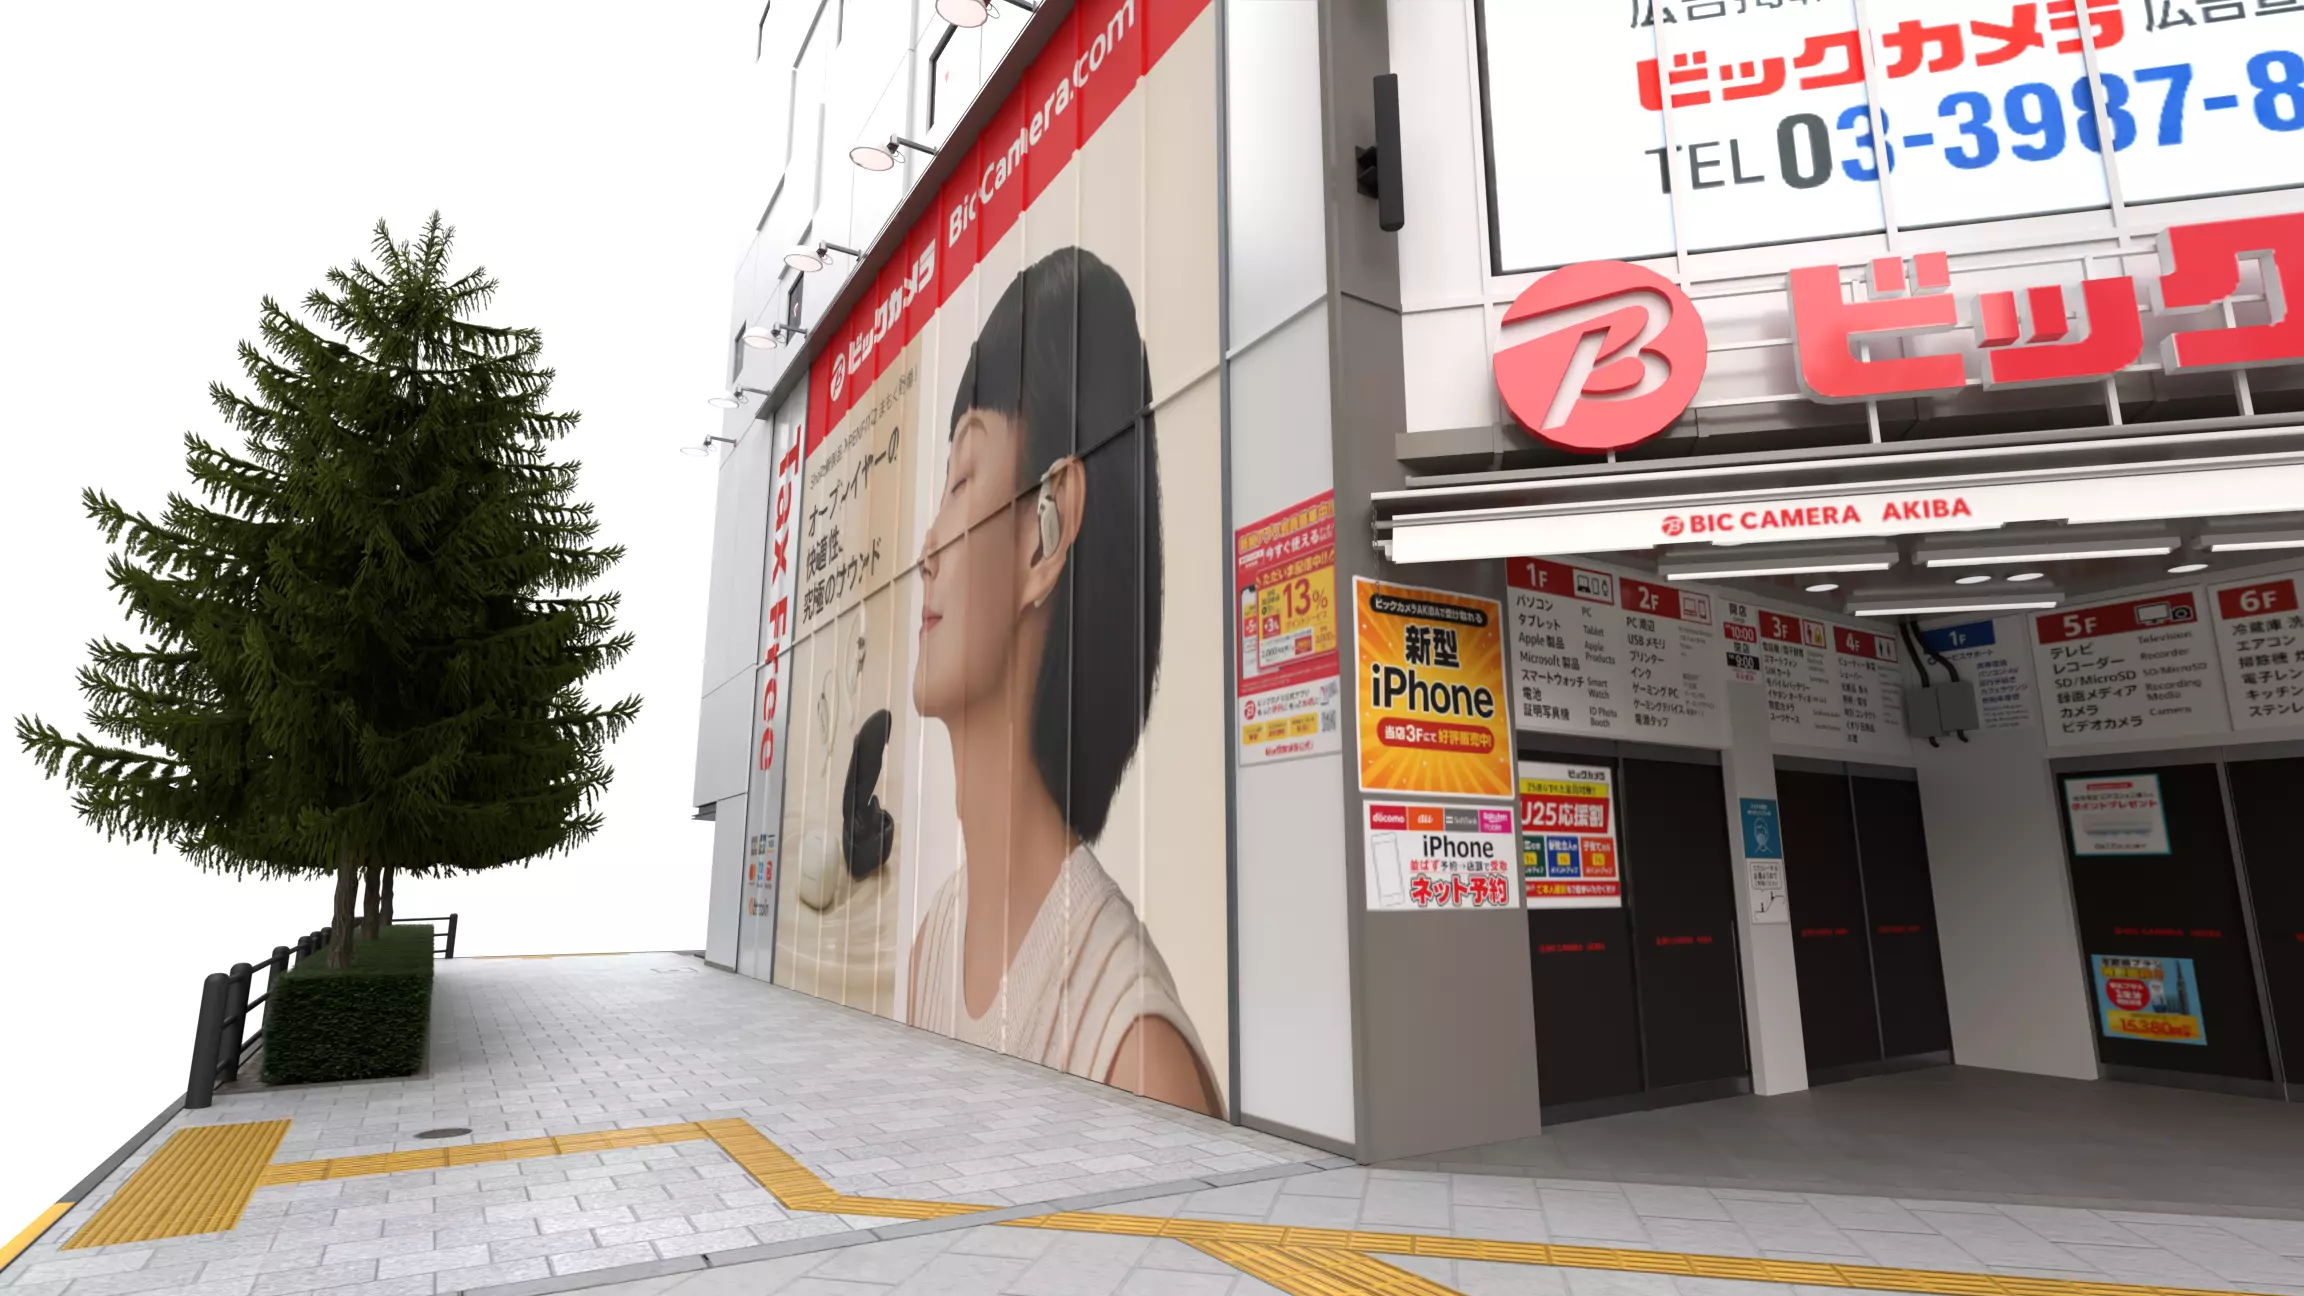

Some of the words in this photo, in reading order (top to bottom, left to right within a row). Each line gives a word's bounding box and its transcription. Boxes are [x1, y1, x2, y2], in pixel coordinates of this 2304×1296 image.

[1637, 0, 2125, 111] ビックカメラ
[1644, 138, 1765, 194] TEL
[848, 238, 936, 375] ビックカメラ
[772, 424, 801, 586] Tax
[1690, 513, 1734, 533] BIC
[1740, 504, 1861, 529] CAMERA
[1882, 497, 1972, 522] AKIBA
[1526, 562, 1547, 589] 1F
[1283, 577, 1328, 619] 13%
[1516, 594, 1554, 612] パソコン
[1638, 586, 1659, 611] 2F
[2239, 589, 2278, 612] 6F
[1581, 606, 1592, 618] PC
[1518, 613, 1561, 630] タブレット
[1626, 617, 1637, 629] PC
[1772, 617, 1788, 639] 3F
[2063, 615, 2097, 637] 5F
[1583, 625, 1604, 637] Tablet
[1731, 626, 1754, 641] 10:00
[1949, 630, 1966, 646] 1F
[2137, 629, 2193, 645] Television
[1405, 624, 1460, 669] 新型
[1519, 632, 1545, 647] Apple
[1547, 636, 1565, 650] 製品
[1627, 634, 1644, 646] USB
[1646, 636, 1665, 650] メモリ
[1845, 632, 1860, 654] 4F
[2236, 636, 2296, 651] エアコン
[1585, 651, 1616, 665] Products
[1629, 650, 1665, 665] プリンター
[2050, 642, 2094, 660] テレビ
[2140, 647, 2190, 662] Recorder
[1520, 651, 1561, 667] Microsoft
[1562, 656, 1580, 671] 製品
[1735, 655, 1754, 669] 9:00
[1764, 655, 1798, 668] スマートフォン
[2053, 657, 2125, 675] レコーダー
[1521, 668, 1584, 688] スマートウォッチ
[1587, 677, 1608, 688] Smart
[1630, 667, 1652, 680] インク
[2055, 669, 2137, 689] SD/MicroSD
[1372, 663, 1494, 718] iPhone
[1632, 682, 1667, 698] ゲーミング
[1668, 687, 1678, 699] PC
[2145, 678, 2202, 691] Recording
[2246, 686, 2304, 701] キッチン
[1522, 686, 1542, 702] 電池
[1588, 688, 1610, 700] Watch
[2056, 684, 2137, 704] 録画メディア
[2146, 690, 2181, 702] Media
[1523, 703, 1570, 721] 証明写真機
[1634, 713, 1669, 728] 電源タップ
[2060, 705, 2099, 718] カメラ
[2062, 715, 2143, 733] ビデオカメラ
[1373, 811, 1405, 823] docomo
[1423, 834, 1494, 858] iPhone
[1410, 873, 1509, 908] ネット予約
